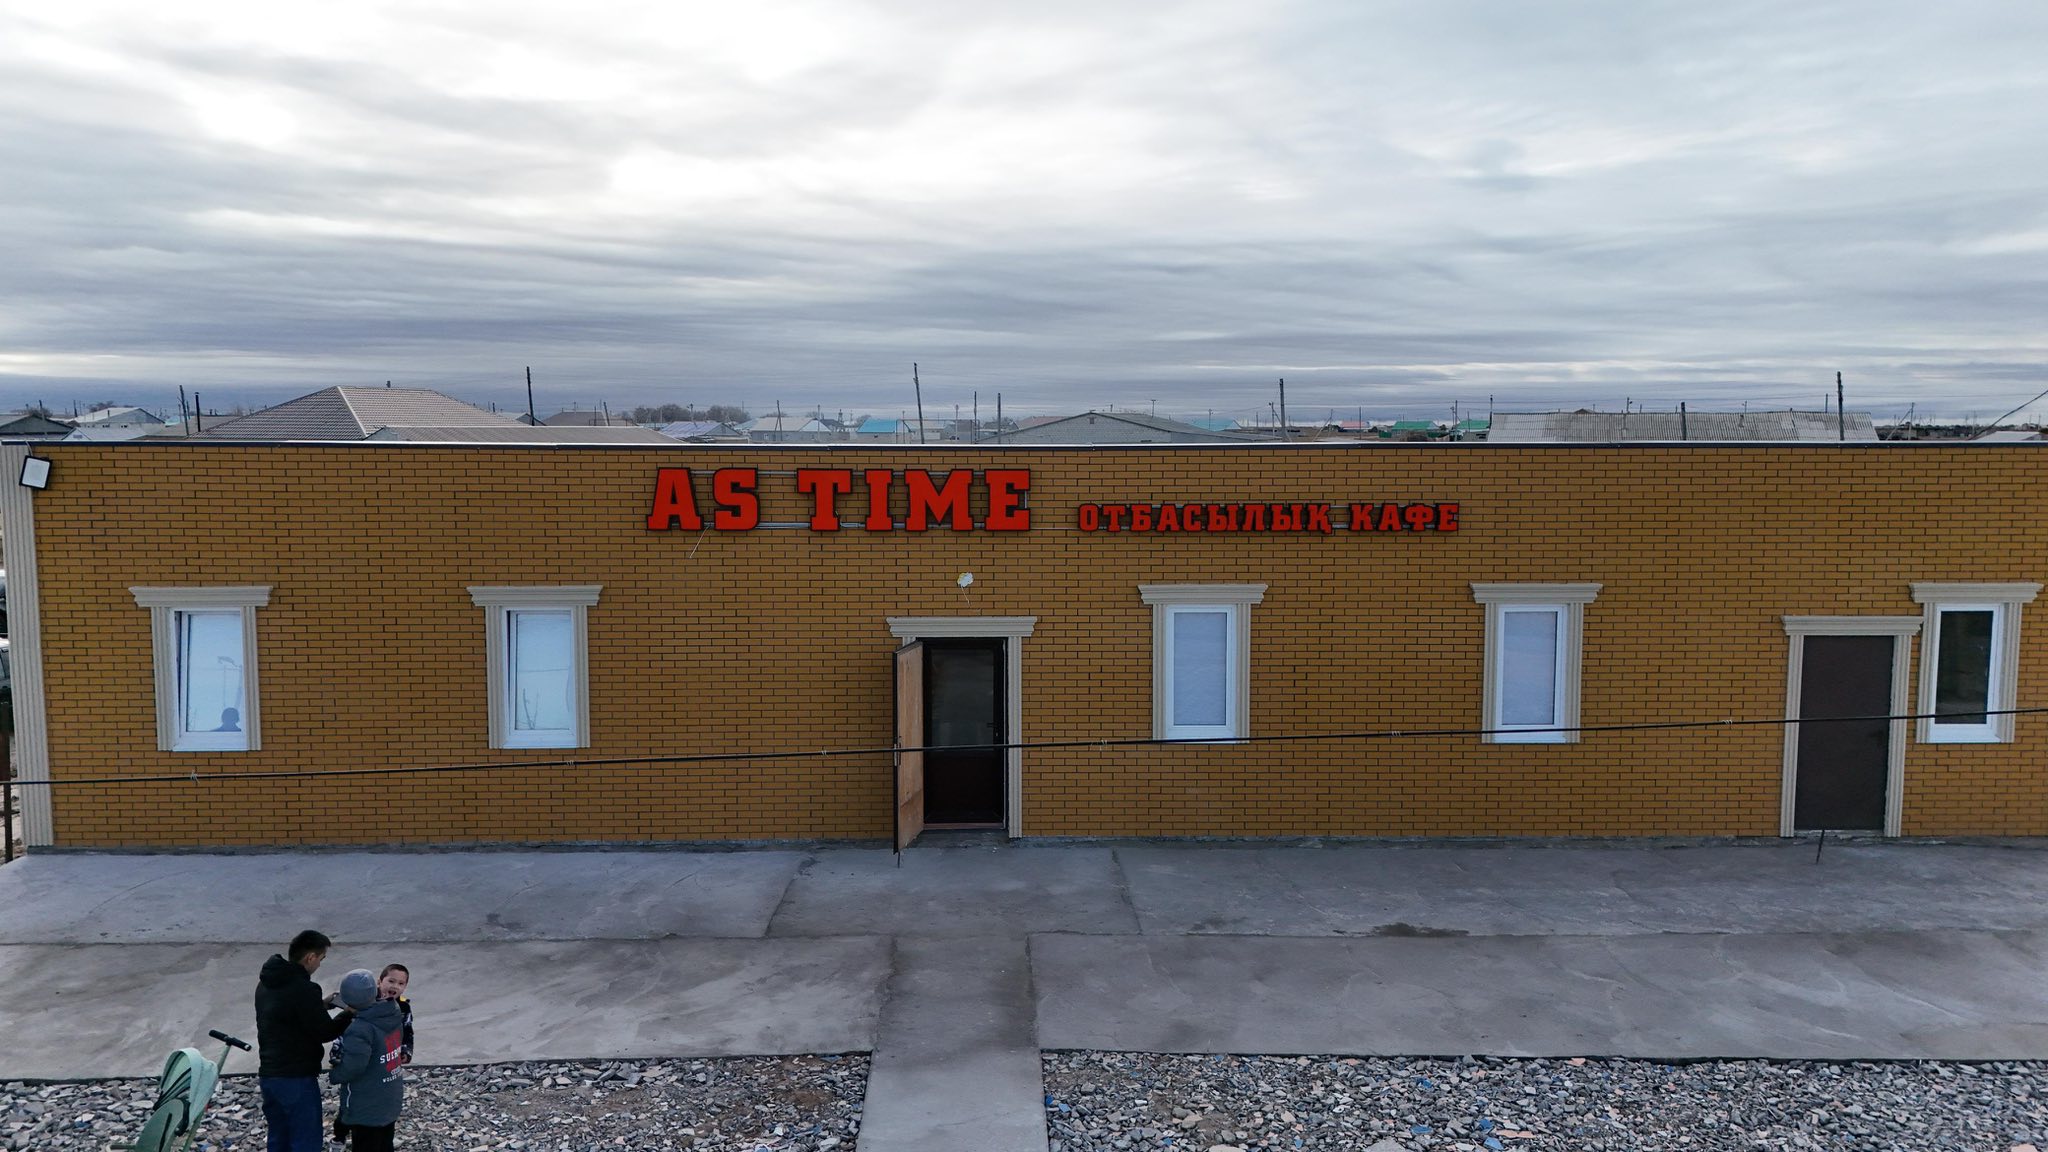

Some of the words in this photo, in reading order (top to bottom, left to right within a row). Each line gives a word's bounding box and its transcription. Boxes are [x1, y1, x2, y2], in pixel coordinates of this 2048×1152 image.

[647, 467, 759, 531] AS
[797, 468, 1031, 531] TIME
[1078, 503, 1333, 534] ОТБАСЫЛЫҚ
[1349, 502, 1460, 532] КАФЕ
